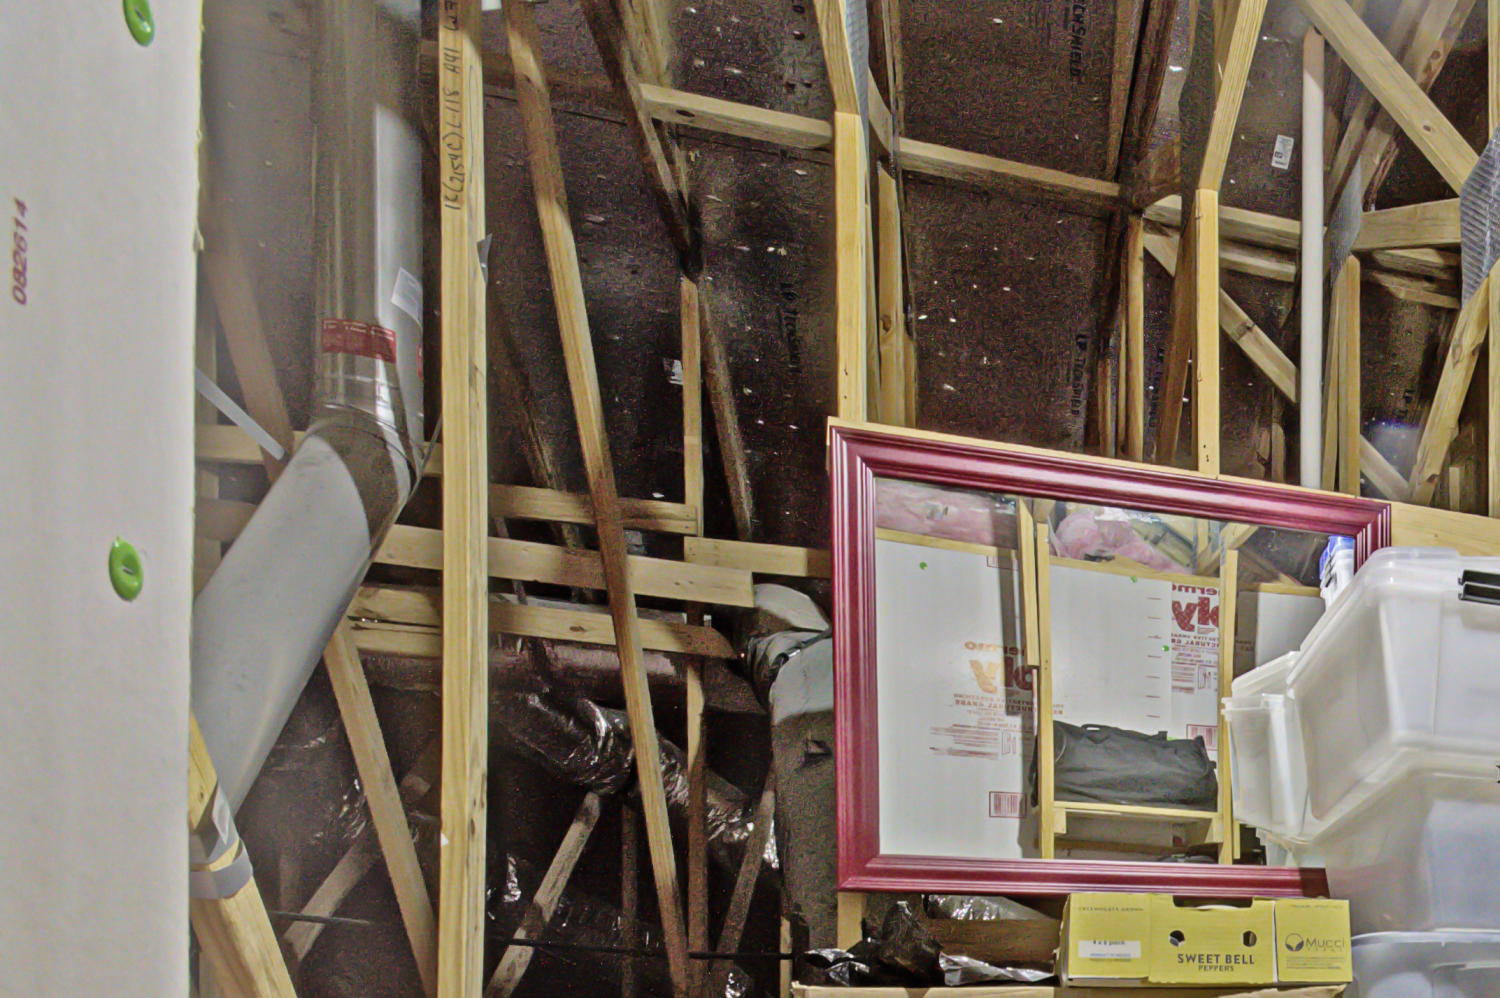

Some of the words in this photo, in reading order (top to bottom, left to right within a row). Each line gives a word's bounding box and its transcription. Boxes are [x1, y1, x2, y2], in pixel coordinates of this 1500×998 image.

[12, 196, 28, 306] 082614
[1305, 937, 1344, 948] Mucci
[1177, 953, 1220, 964] SWEET
[1225, 954, 1255, 965] BELL
[1198, 964, 1234, 972] PEPPERS
